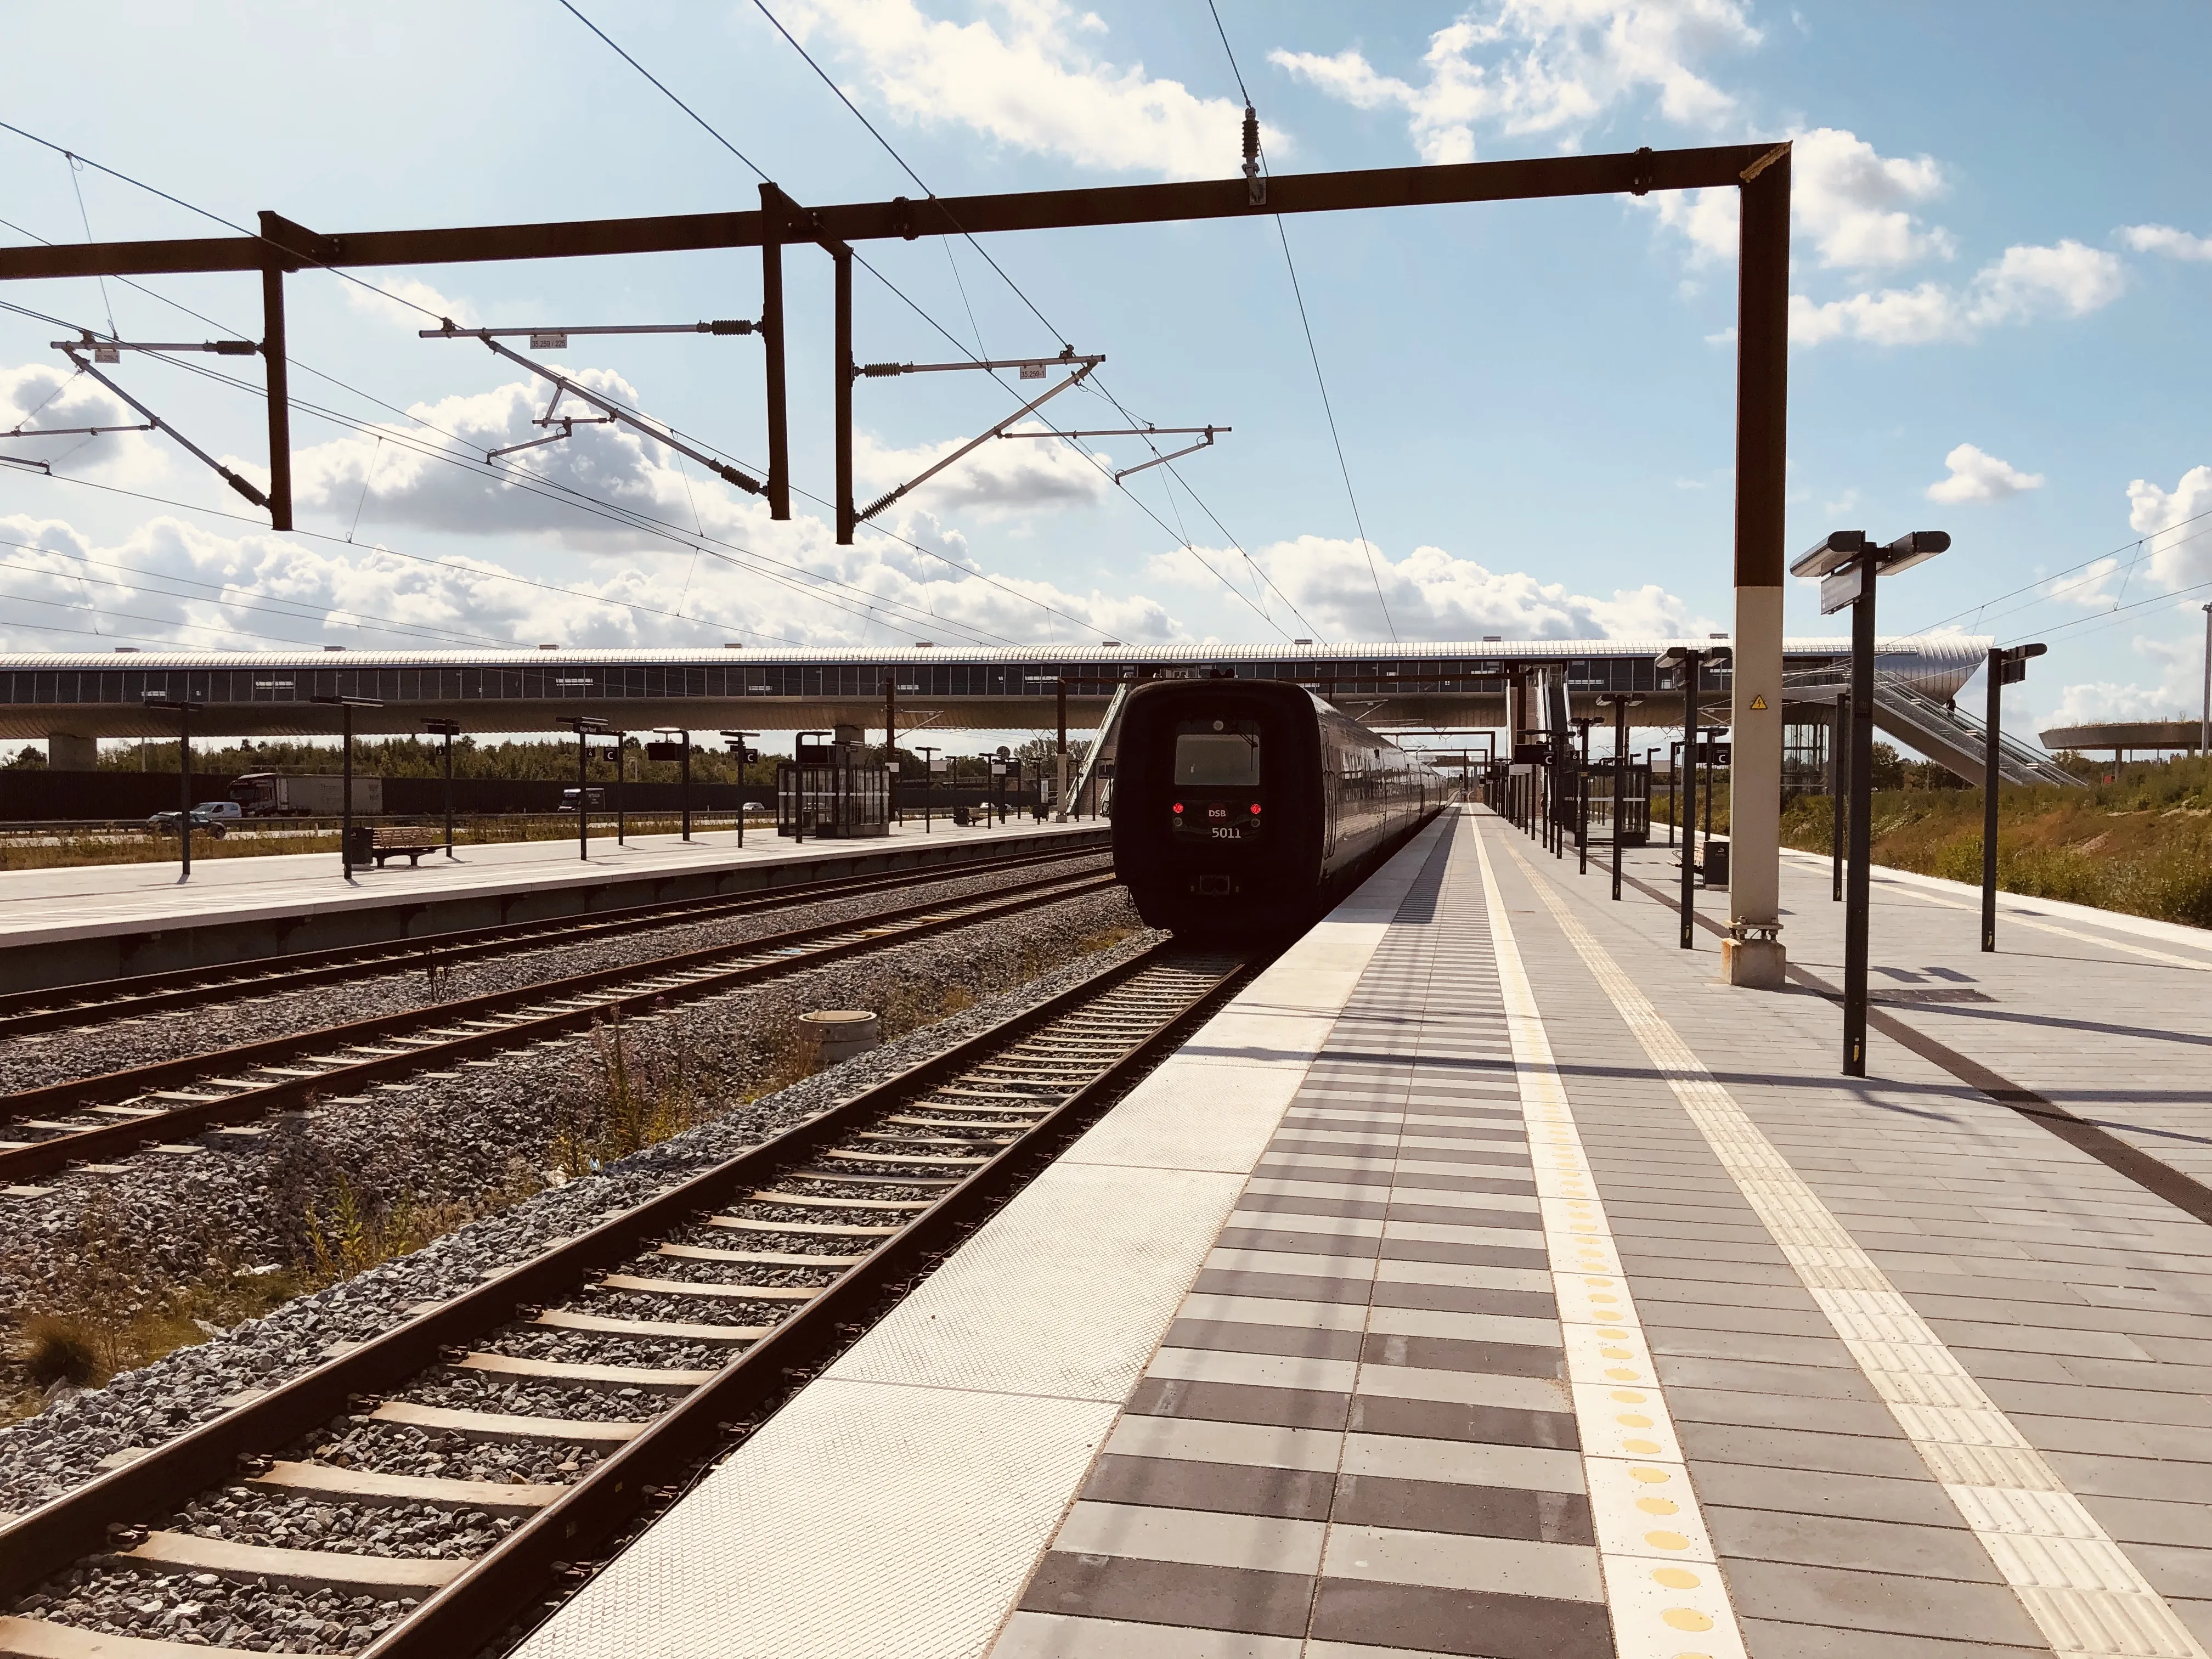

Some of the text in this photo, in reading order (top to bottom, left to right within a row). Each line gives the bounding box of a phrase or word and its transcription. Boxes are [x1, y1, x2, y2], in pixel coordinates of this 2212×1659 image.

[607, 752, 613, 760] C
[747, 754, 754, 762] C
[1545, 755, 1553, 765] C
[1718, 754, 1726, 763] C
[1212, 827, 1242, 838] 5011
